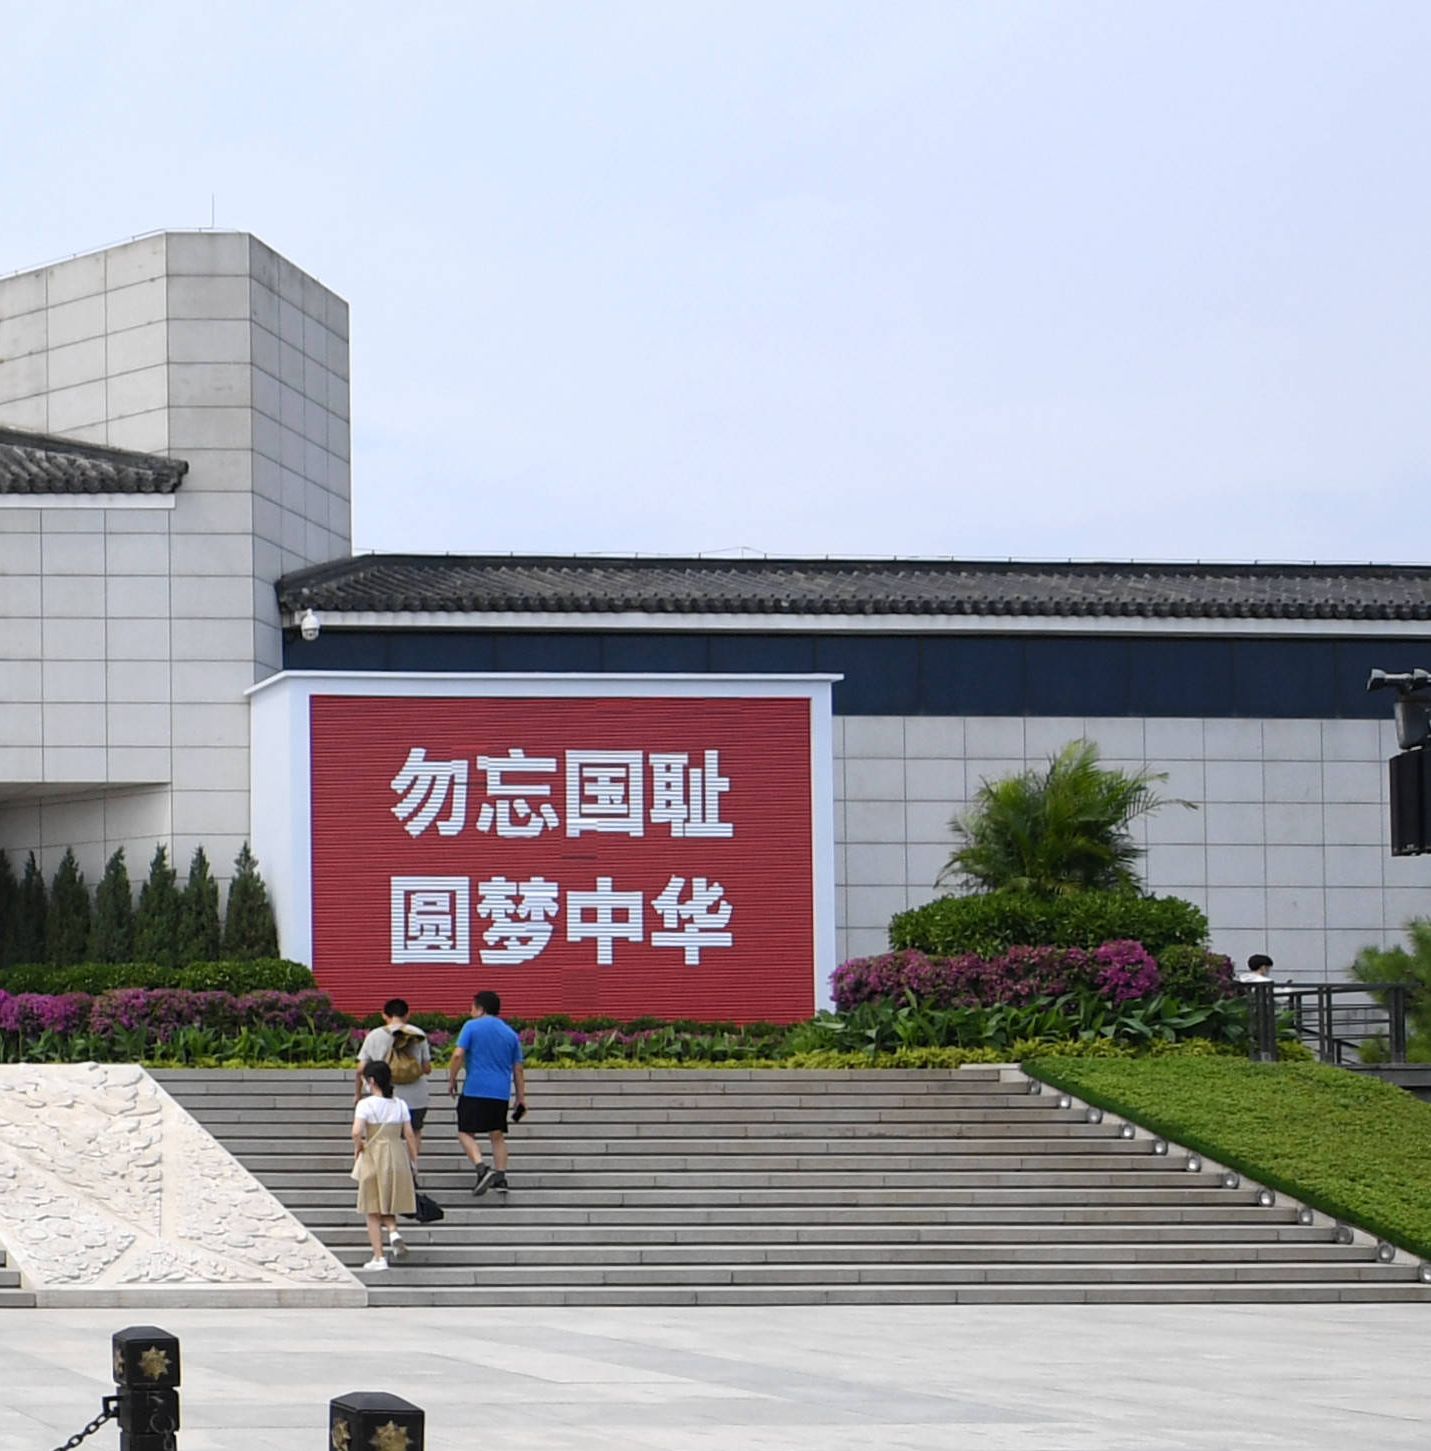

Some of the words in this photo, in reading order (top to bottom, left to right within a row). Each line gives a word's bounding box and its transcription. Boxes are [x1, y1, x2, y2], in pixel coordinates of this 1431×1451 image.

[390, 748, 734, 838] 勿忘国耻
[390, 874, 734, 966] 圆梦中华
